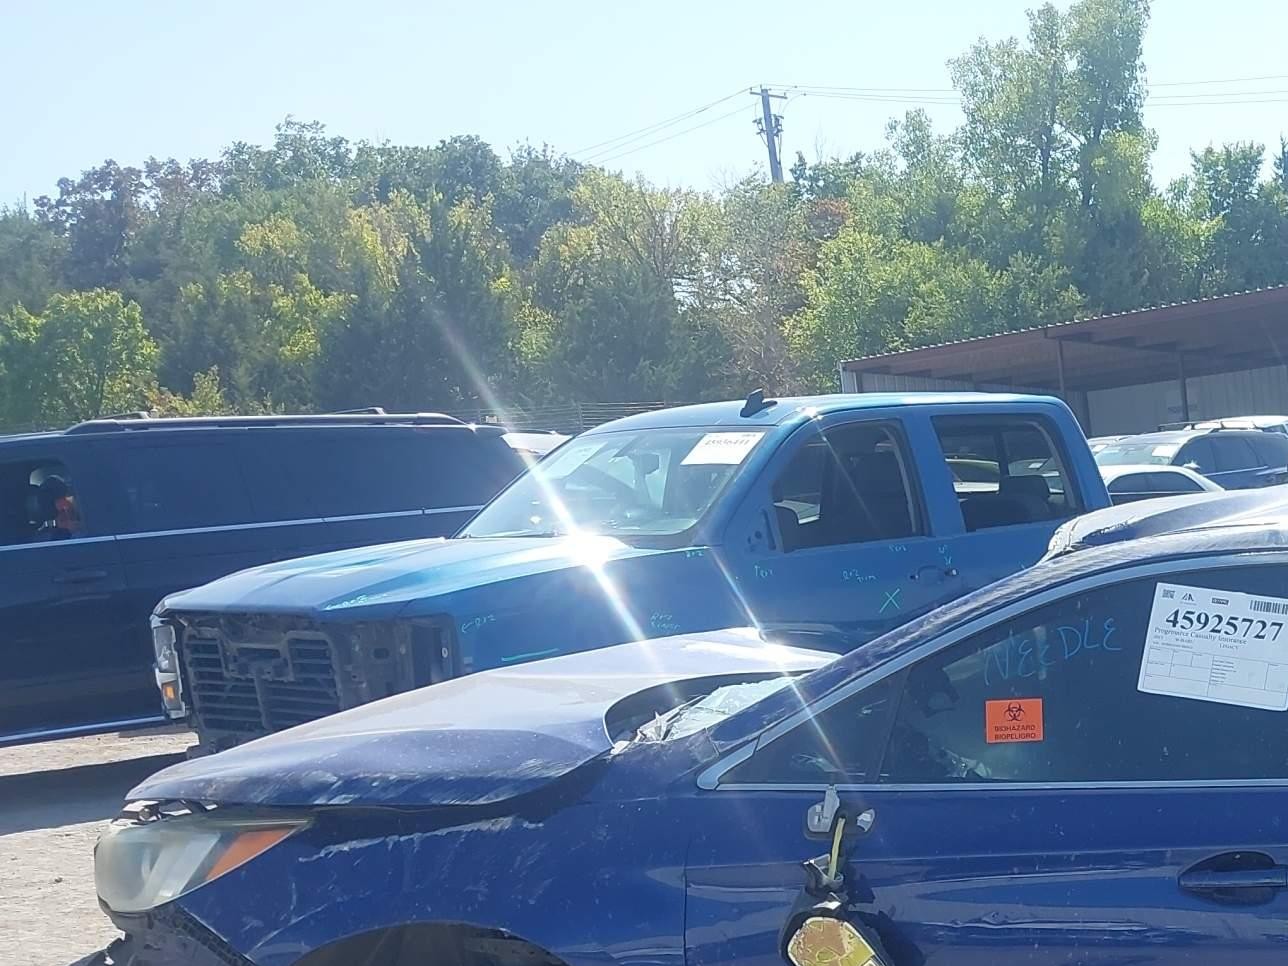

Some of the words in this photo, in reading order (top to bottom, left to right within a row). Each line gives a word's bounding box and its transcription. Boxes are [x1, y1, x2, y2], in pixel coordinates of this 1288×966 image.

[1165, 608, 1284, 642] 45925727
[1190, 631, 1217, 641] Casualty
[1218, 635, 1247, 645] Insurance
[994, 724, 1036, 732] BIOHAZARD
[994, 732, 1036, 740] BIOPELIGRO
